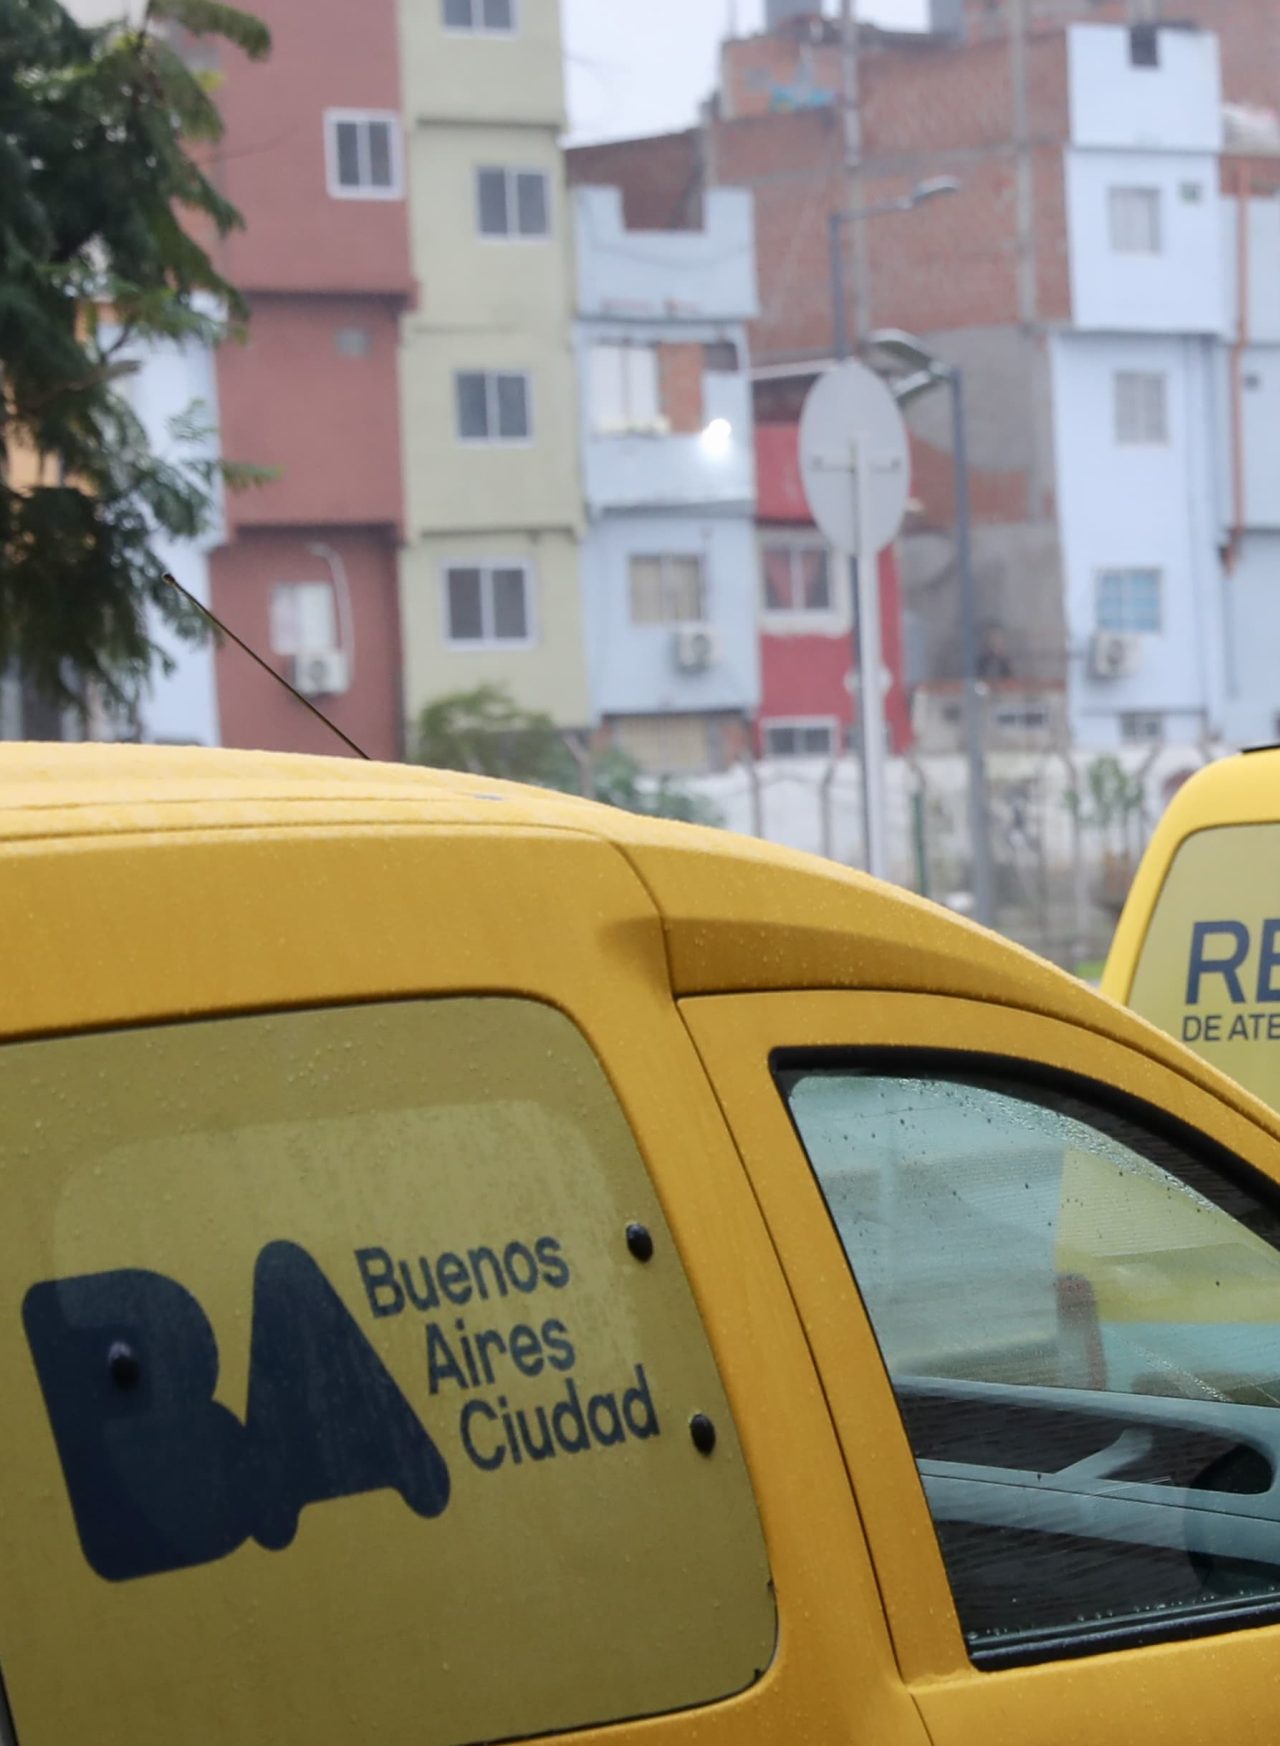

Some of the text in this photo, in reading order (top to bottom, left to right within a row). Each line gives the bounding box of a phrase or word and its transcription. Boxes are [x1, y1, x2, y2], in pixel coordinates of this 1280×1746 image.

[1182, 1015, 1222, 1042] DE
[354, 1236, 570, 1319] Buenos
[425, 1318, 576, 1395] Aires
[21, 1239, 451, 1583] BA
[460, 1364, 660, 1471] Ciudad
